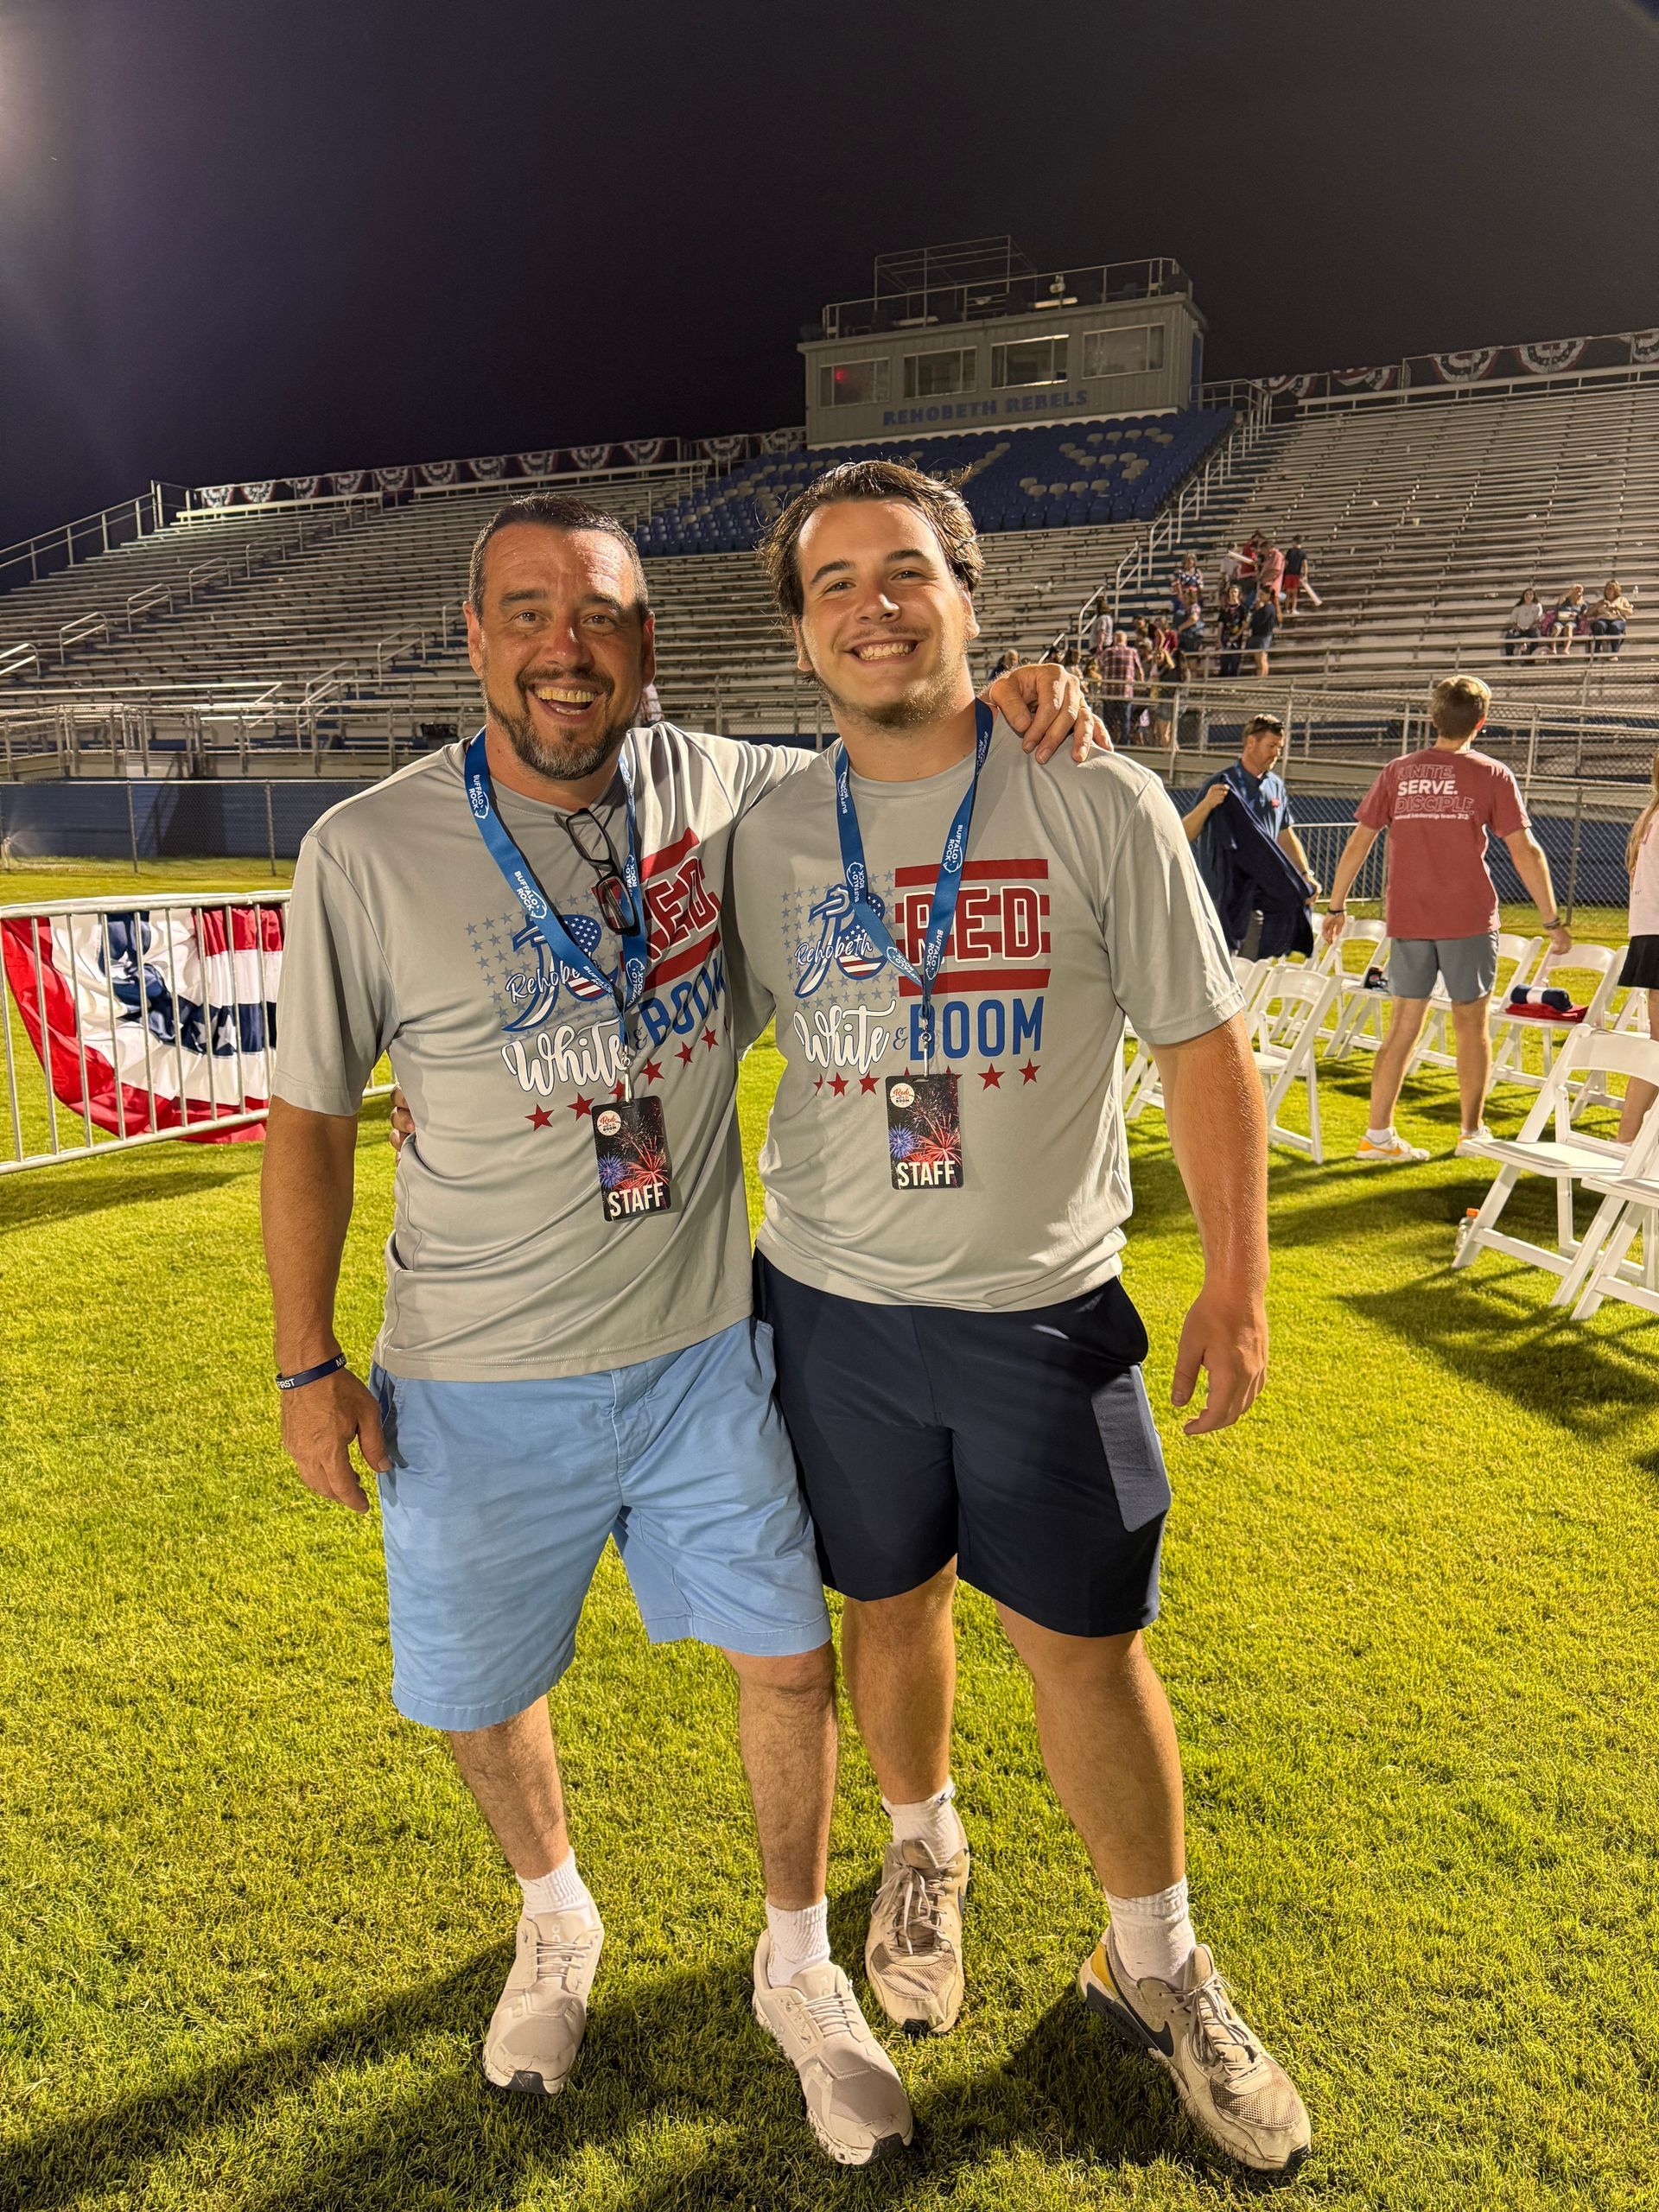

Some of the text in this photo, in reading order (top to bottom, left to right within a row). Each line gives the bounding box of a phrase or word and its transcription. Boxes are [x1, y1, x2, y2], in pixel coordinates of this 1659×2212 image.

[883, 390, 1087, 426] REHOBETH REBELS
[469, 788, 479, 810] ROCK
[474, 774, 484, 804] BUFFALO
[1397, 779, 1458, 796] SERVE.
[945, 839, 955, 861] ROCK
[952, 824, 963, 860] BUFFALO
[514, 871, 537, 905] BUFFALO
[517, 888, 534, 911] ROCK
[644, 856, 717, 963] ED
[904, 886, 1042, 966] RED
[794, 932, 873, 969] Rehobeth
[896, 953, 914, 970] ROCK
[931, 929, 944, 966] BUFFALO
[794, 996, 1044, 1075] White & BOOM
[501, 1018, 628, 1096] White
[897, 1160, 955, 1186] STAFF
[608, 1181, 664, 1217] STAFF
